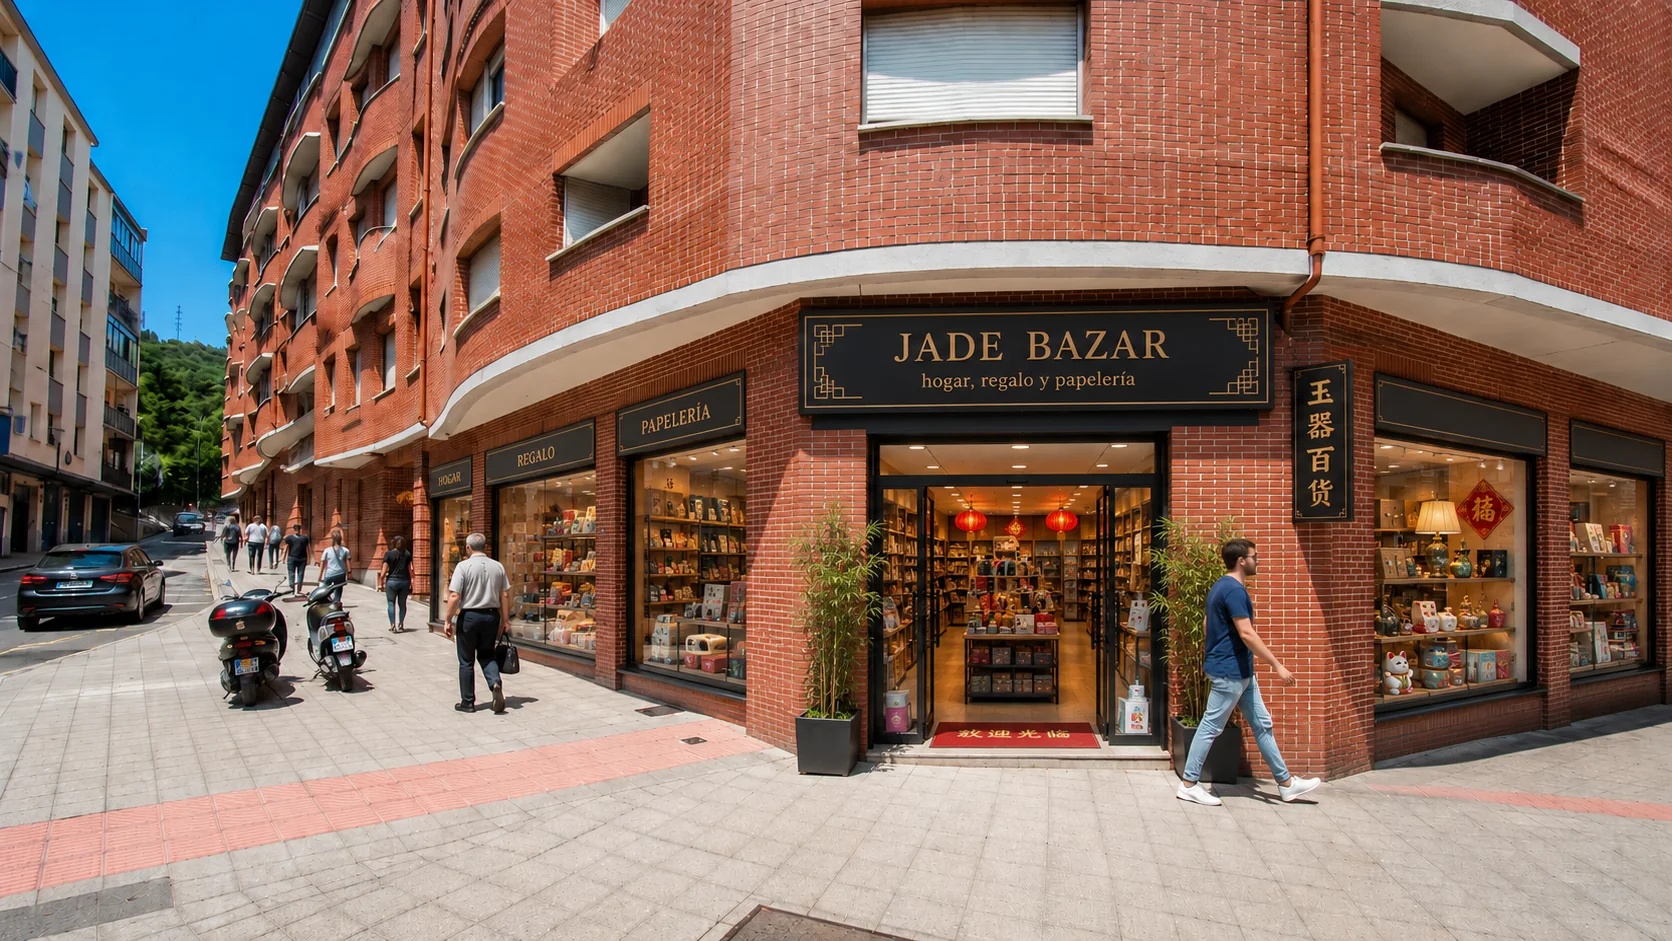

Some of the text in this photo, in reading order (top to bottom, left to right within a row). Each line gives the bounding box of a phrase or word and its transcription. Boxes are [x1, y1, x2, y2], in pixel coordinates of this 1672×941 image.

[894, 329, 1170, 363] JADE BAZAR
[921, 371, 1136, 393] hogar, regalo y papelería
[641, 402, 712, 435] PAPELERÍA
[517, 446, 556, 467] REGALO
[1306, 378, 1336, 508] 玉器百货
[438, 471, 462, 487] HOGAR
